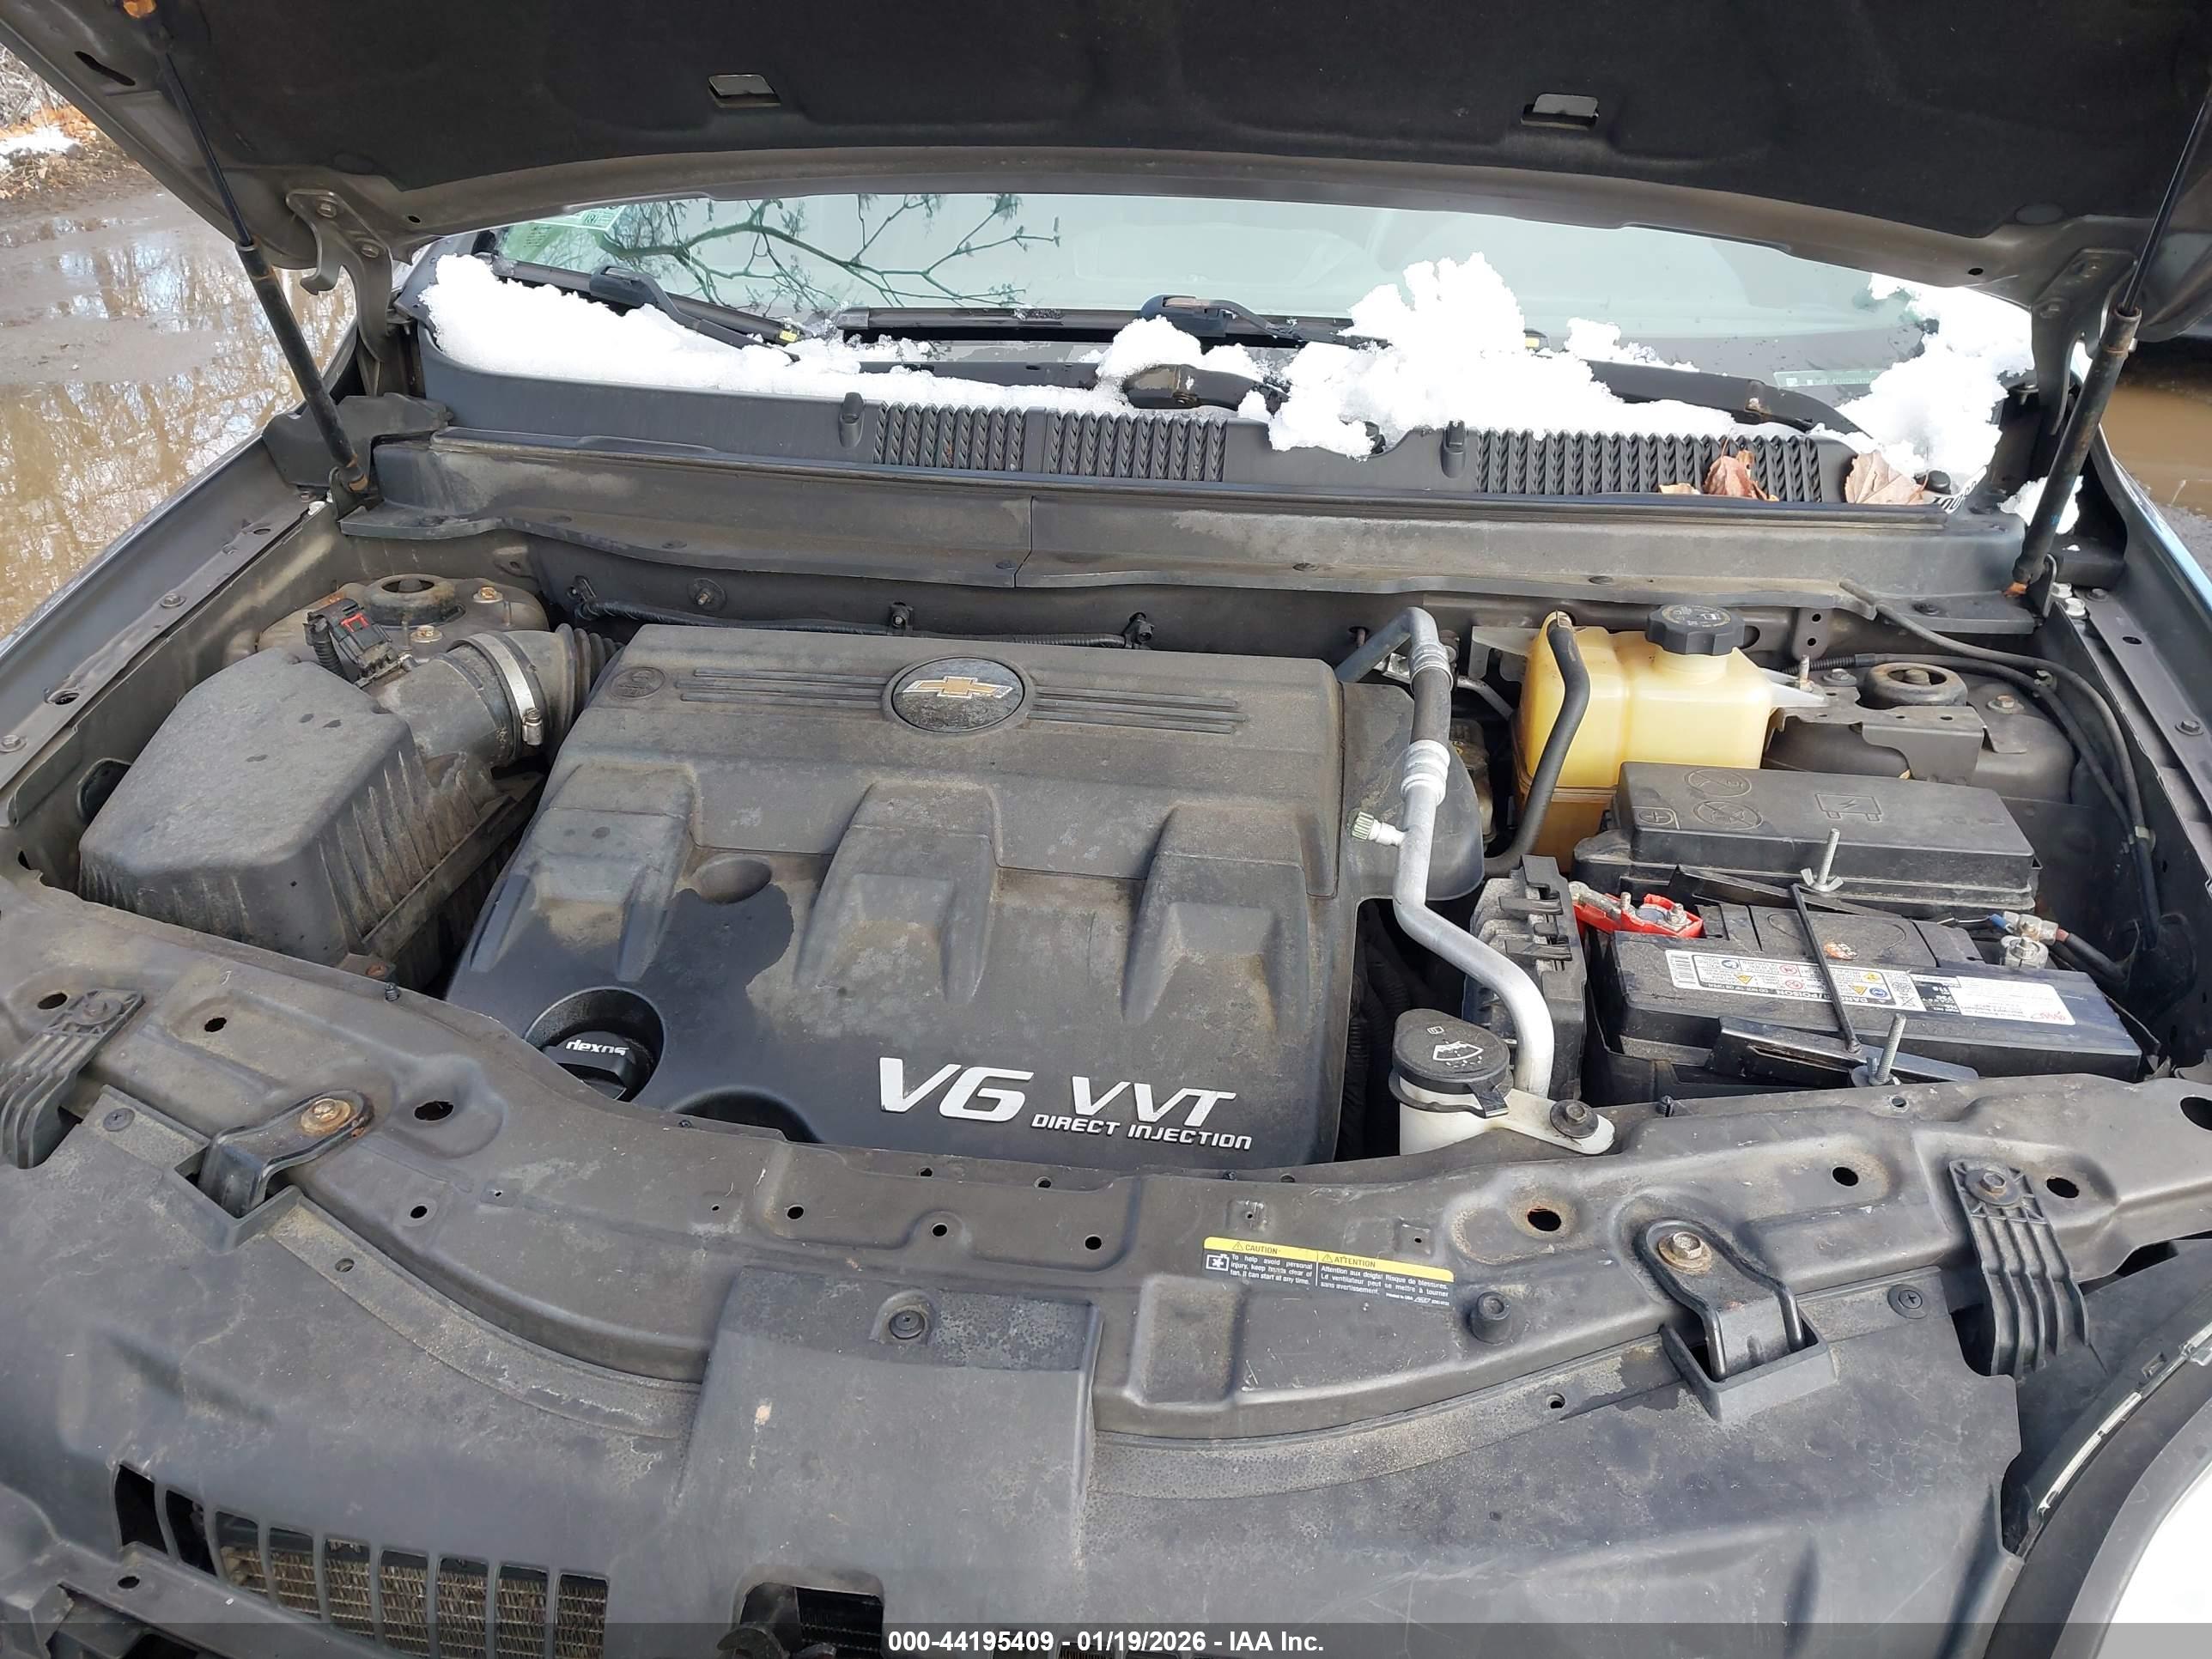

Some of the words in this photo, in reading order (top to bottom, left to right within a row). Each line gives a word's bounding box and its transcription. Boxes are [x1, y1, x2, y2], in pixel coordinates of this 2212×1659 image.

[878, 1056, 1035, 1123] V6
[1072, 1074, 1238, 1128] VVT
[1030, 1113, 1121, 1138] DIRECT
[1127, 1123, 1253, 1152] INJECTION
[1245, 1244, 1278, 1255] CAUTION
[1263, 1257, 1280, 1266] avoid
[1285, 1261, 1312, 1270] personal
[1334, 1256, 1376, 1267] ATTENTION
[1251, 1263, 1266, 1272] keep
[1267, 1265, 1286, 1273] hands
[1288, 1267, 1304, 1276] clear
[1295, 1277, 1310, 1285] time.
[1321, 1266, 1347, 1274] Attention
[1386, 1274, 1406, 1284] Risque
[1418, 1279, 1449, 1290] blessures.
[1332, 1275, 1364, 1285] ventilateur
[1395, 1284, 1416, 1293] mettre
[1426, 1288, 1449, 1297] tourner
